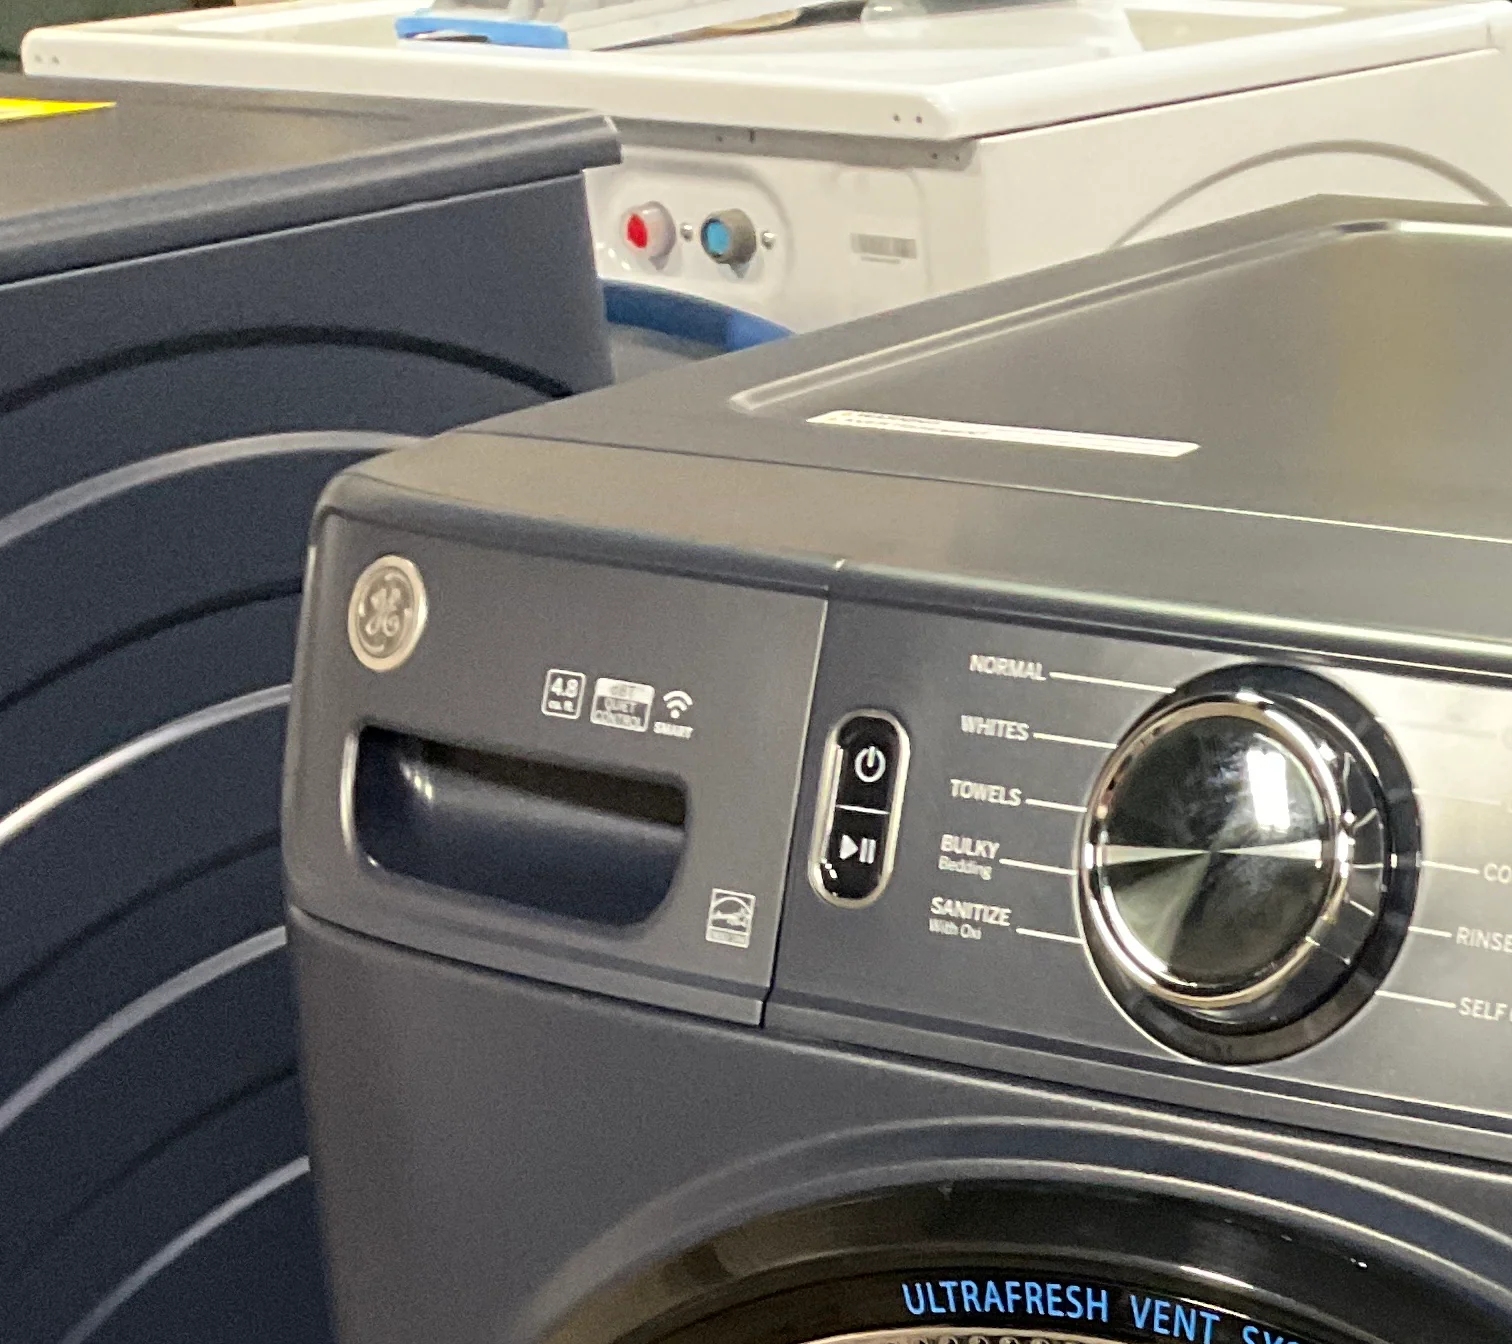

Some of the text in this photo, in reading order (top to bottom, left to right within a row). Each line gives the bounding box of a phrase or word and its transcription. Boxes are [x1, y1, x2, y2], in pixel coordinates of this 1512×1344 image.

[969, 654, 1046, 681] NORMAL
[551, 677, 578, 698] 4.8
[961, 714, 1029, 741] WHITES
[950, 778, 1022, 806] TOWELS
[940, 834, 1000, 859] BULKY
[938, 855, 992, 880] Bedding
[930, 896, 1012, 926] SANITIZE
[1459, 997, 1508, 1021] SELF
[901, 1280, 1108, 1322] ULTRAFRESH
